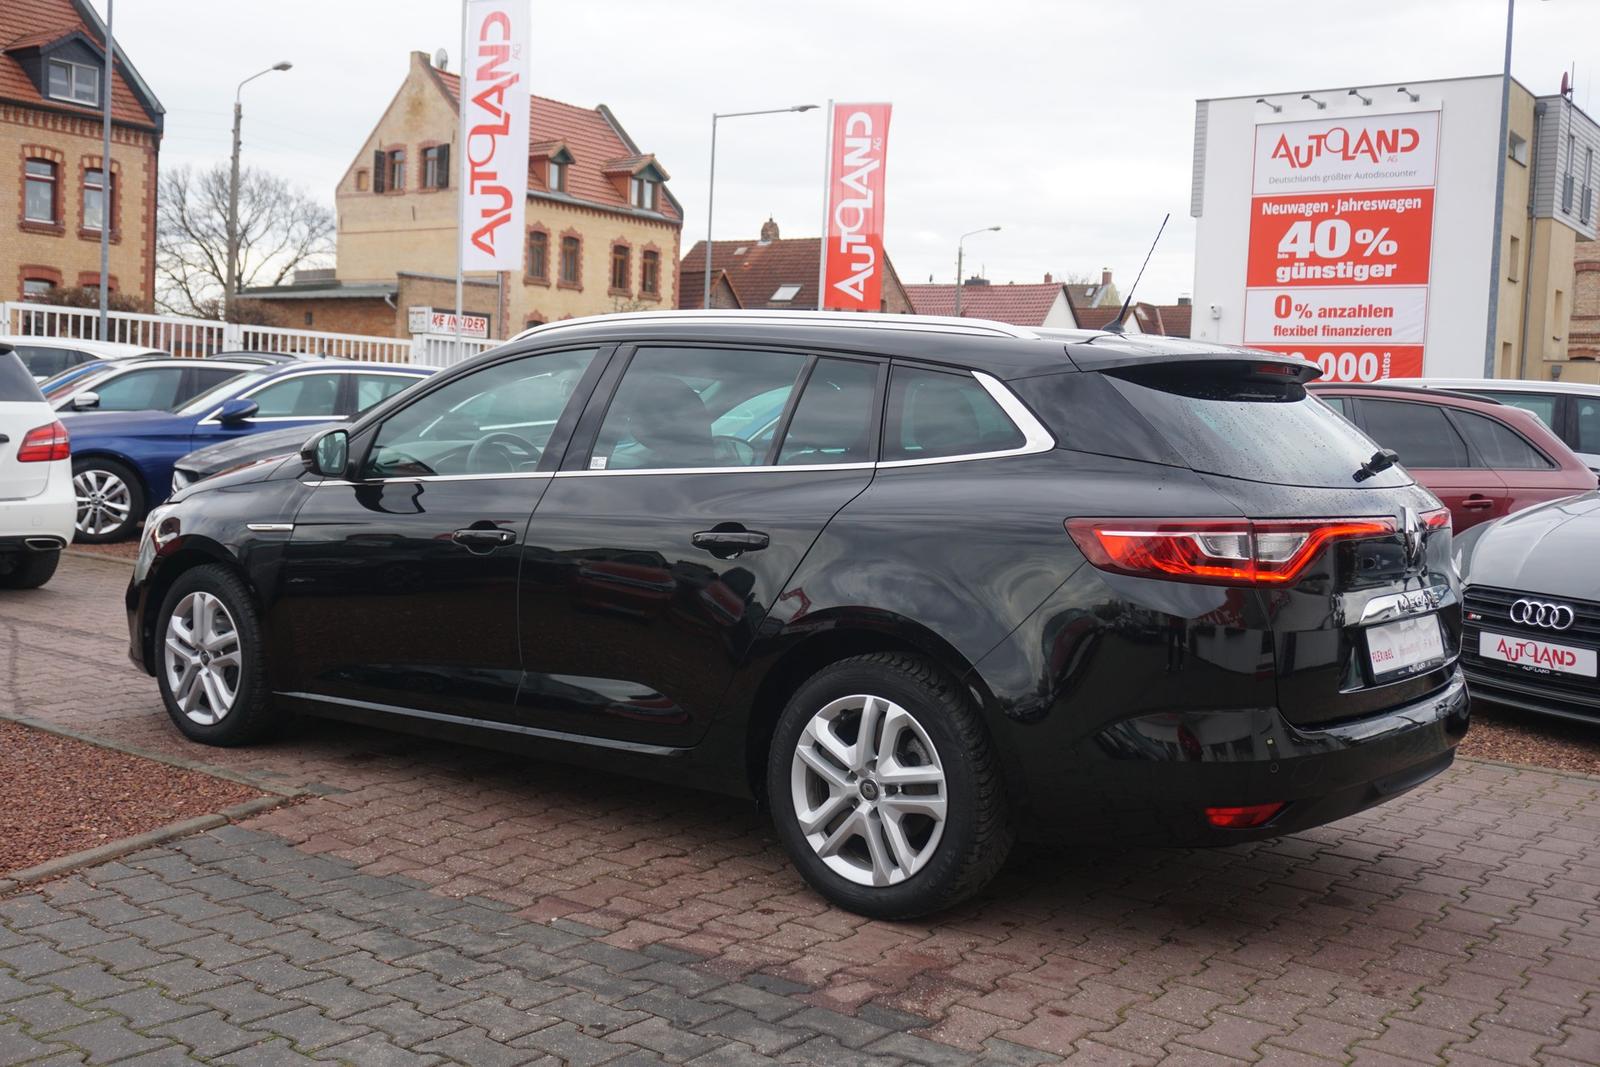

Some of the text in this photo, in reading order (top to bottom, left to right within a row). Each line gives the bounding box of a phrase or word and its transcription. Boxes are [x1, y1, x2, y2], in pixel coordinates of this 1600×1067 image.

[467, 11, 519, 257] AUTOLAND
[1271, 127, 1420, 168] AUTOLAND
[1269, 169, 1417, 185] Deutschlands größter Autodiscounter
[833, 111, 880, 302] AUTOLAND
[1262, 198, 1422, 216] Neuwagen Jahreswagen
[1276, 261, 1397, 283] günstiger
[1318, 304, 1394, 318] anzahlen
[447, 316, 486, 330] INIDER
[1273, 324, 1392, 337] flexibel finanzieren
[1497, 638, 1576, 668] AUTOLAND
[1521, 665, 1550, 674] AUTLAND
